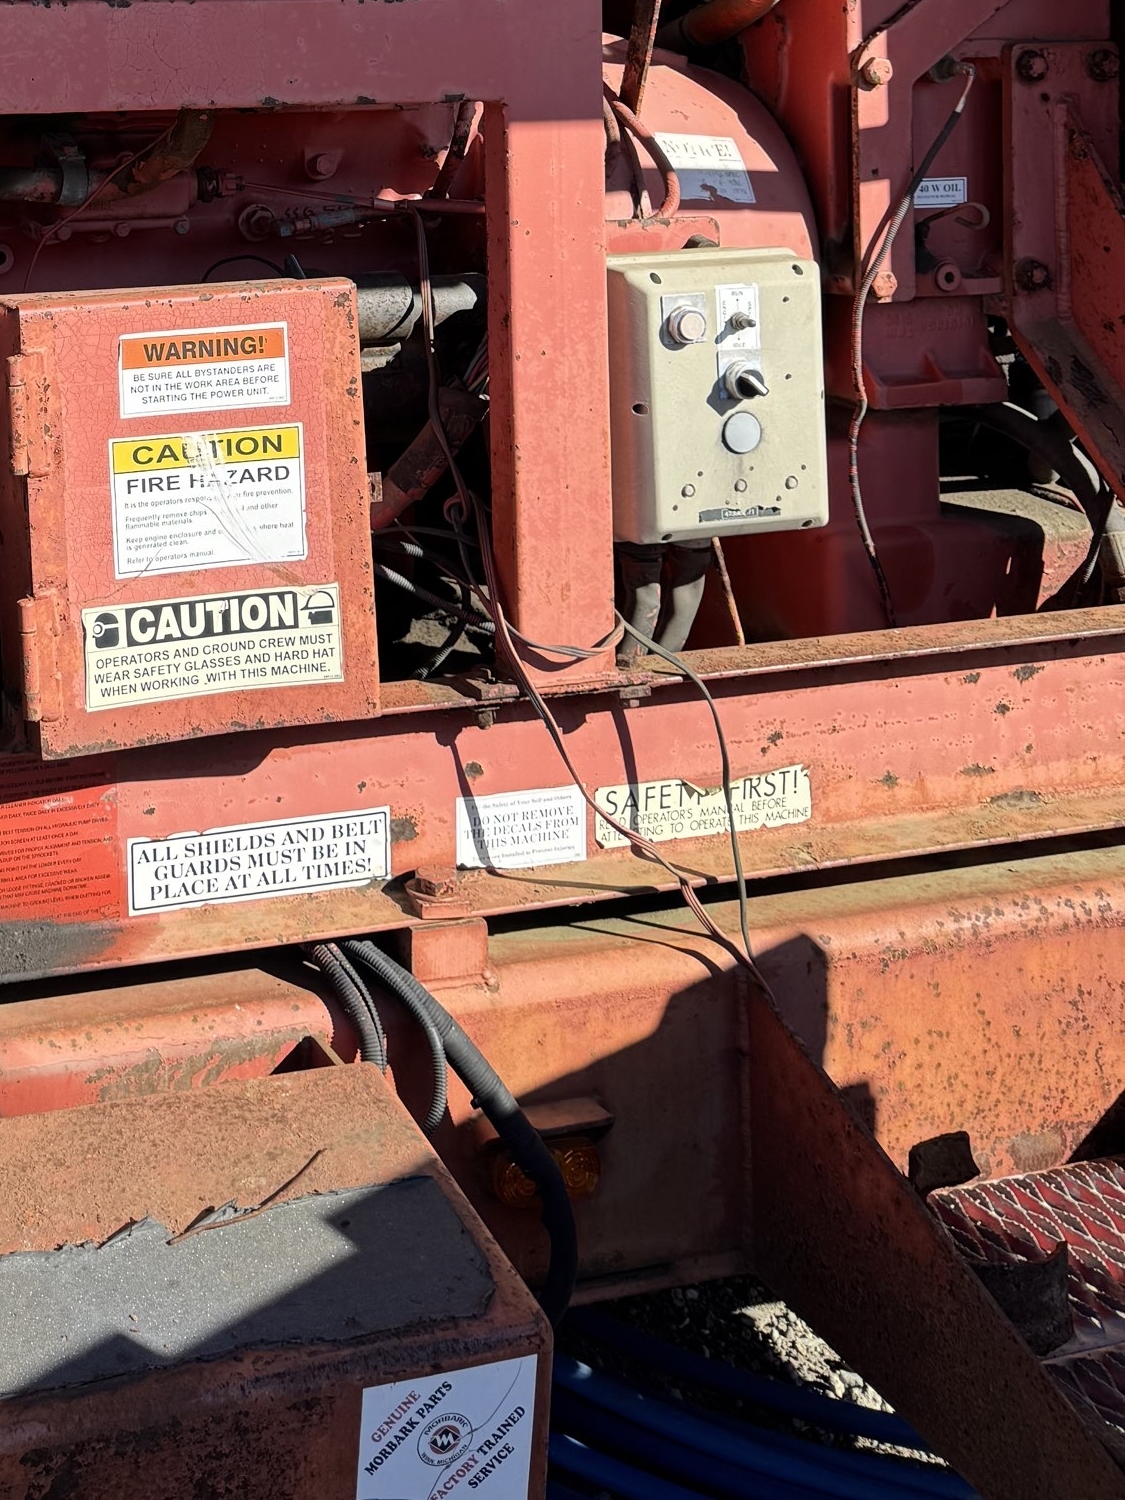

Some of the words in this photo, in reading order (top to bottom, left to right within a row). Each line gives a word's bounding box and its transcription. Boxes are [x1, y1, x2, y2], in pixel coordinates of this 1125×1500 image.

[143, 335, 264, 362] WARNING!
[130, 385, 149, 394] NOT
[165, 382, 182, 391] THE
[185, 380, 213, 390] WORK
[216, 378, 240, 387] AREA
[243, 375, 279, 385] BEFORE
[134, 373, 145, 382] BE
[148, 371, 172, 380] SURE
[176, 369, 192, 378] ALL
[194, 365, 255, 378] BYSTANDERS
[257, 364, 275, 372] ARE
[142, 393, 187, 405] STARTING
[190, 392, 207, 400] THE
[210, 389, 244, 399] POWER
[246, 387, 269, 396] UNIT.
[126, 474, 181, 495] FIRE
[151, 498, 183, 507] operators
[126, 514, 160, 522] Frequently
[134, 541, 167, 551] generated
[169, 531, 202, 539] enclosure
[155, 553, 187, 562] operators
[130, 593, 295, 643] CAUTION
[95, 650, 170, 670] OPERATORS
[173, 646, 199, 659] AND
[202, 640, 256, 656] GROUND
[259, 636, 296, 648] CREW
[300, 634, 332, 645] MUST
[94, 670, 131, 684] WEAR
[133, 662, 181, 679] SAFETY
[184, 655, 241, 672] GLASSES
[245, 653, 270, 664] AND
[275, 650, 309, 662] HARD
[313, 647, 335, 659] HAT
[100, 683, 137, 698] WHEN
[140, 674, 200, 692] WORKING
[205, 670, 237, 683] WITH
[240, 667, 267, 679] THIS
[271, 662, 331, 676] MACHINE.
[473, 816, 490, 827] DO
[494, 813, 519, 823] NOT
[522, 805, 574, 821] REMOVE
[700, 802, 745, 817] MANAL
[752, 797, 787, 811] BEFORE
[464, 827, 490, 839] THE
[493, 821, 542, 836] DECALS
[545, 816, 579, 830] FROM
[670, 822, 684, 833] TO
[739, 813, 759, 825] THIS
[765, 807, 809, 822] MACHINE
[137, 846, 178, 865] ALL
[184, 832, 276, 859] SHIELDS
[281, 826, 325, 846] AND
[331, 818, 383, 838] BELT
[477, 837, 507, 849] THIS
[510, 829, 570, 845] MACHINE
[154, 855, 241, 881] GUARDS
[247, 847, 307, 869] MUST
[312, 843, 339, 861] BE
[345, 839, 367, 856] IN
[149, 877, 219, 902] PLACE
[224, 873, 252, 891] AT
[256, 868, 298, 887] ALL
[301, 857, 372, 881] TIMES!
[364, 1416, 420, 1476] MORBARK
[415, 1380, 453, 1420] PARTS
[371, 1390, 422, 1443] GENUINE
[476, 1405, 526, 1457] TRAINED
[467, 1442, 515, 1489] SERVICE
